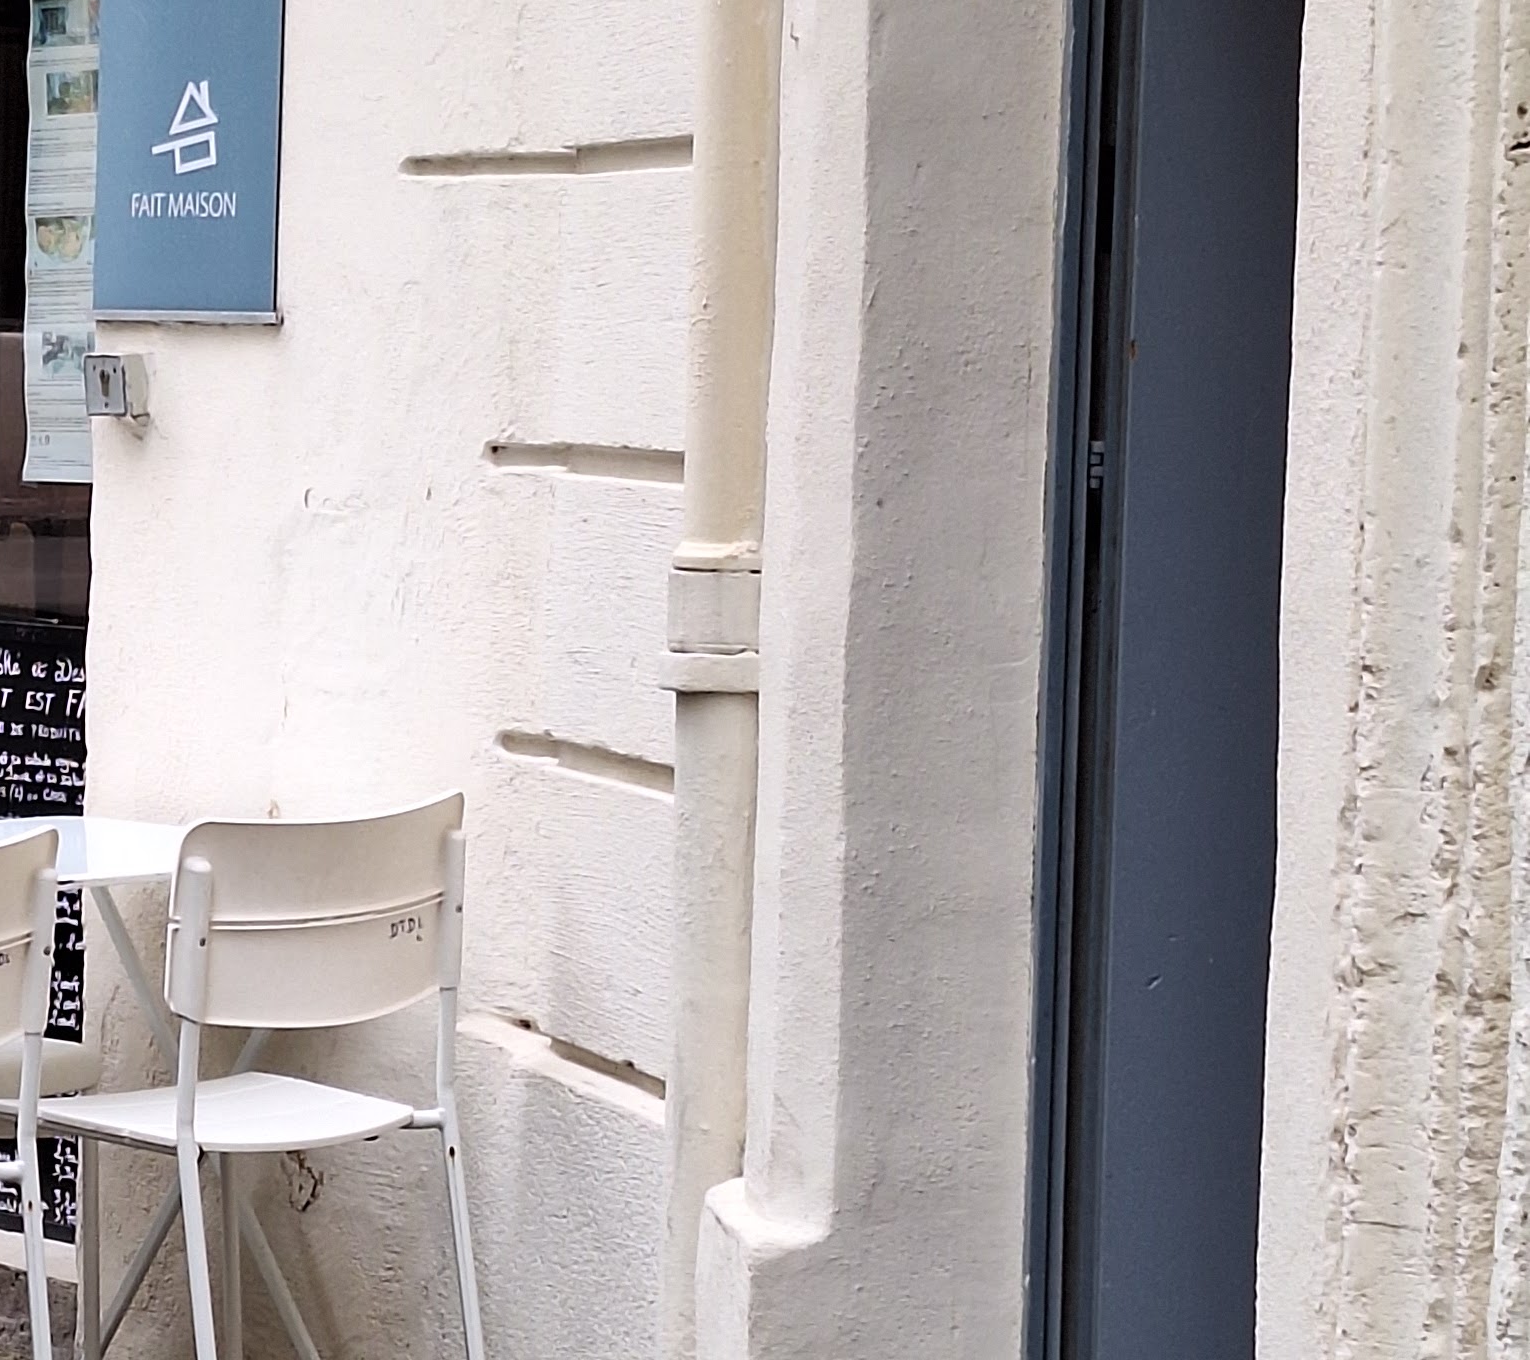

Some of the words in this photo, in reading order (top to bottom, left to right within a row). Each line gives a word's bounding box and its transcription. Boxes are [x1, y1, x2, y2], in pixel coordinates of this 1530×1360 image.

[131, 192, 167, 218] FAIT
[168, 191, 237, 218] MAISON
[24, 690, 57, 716] EST
